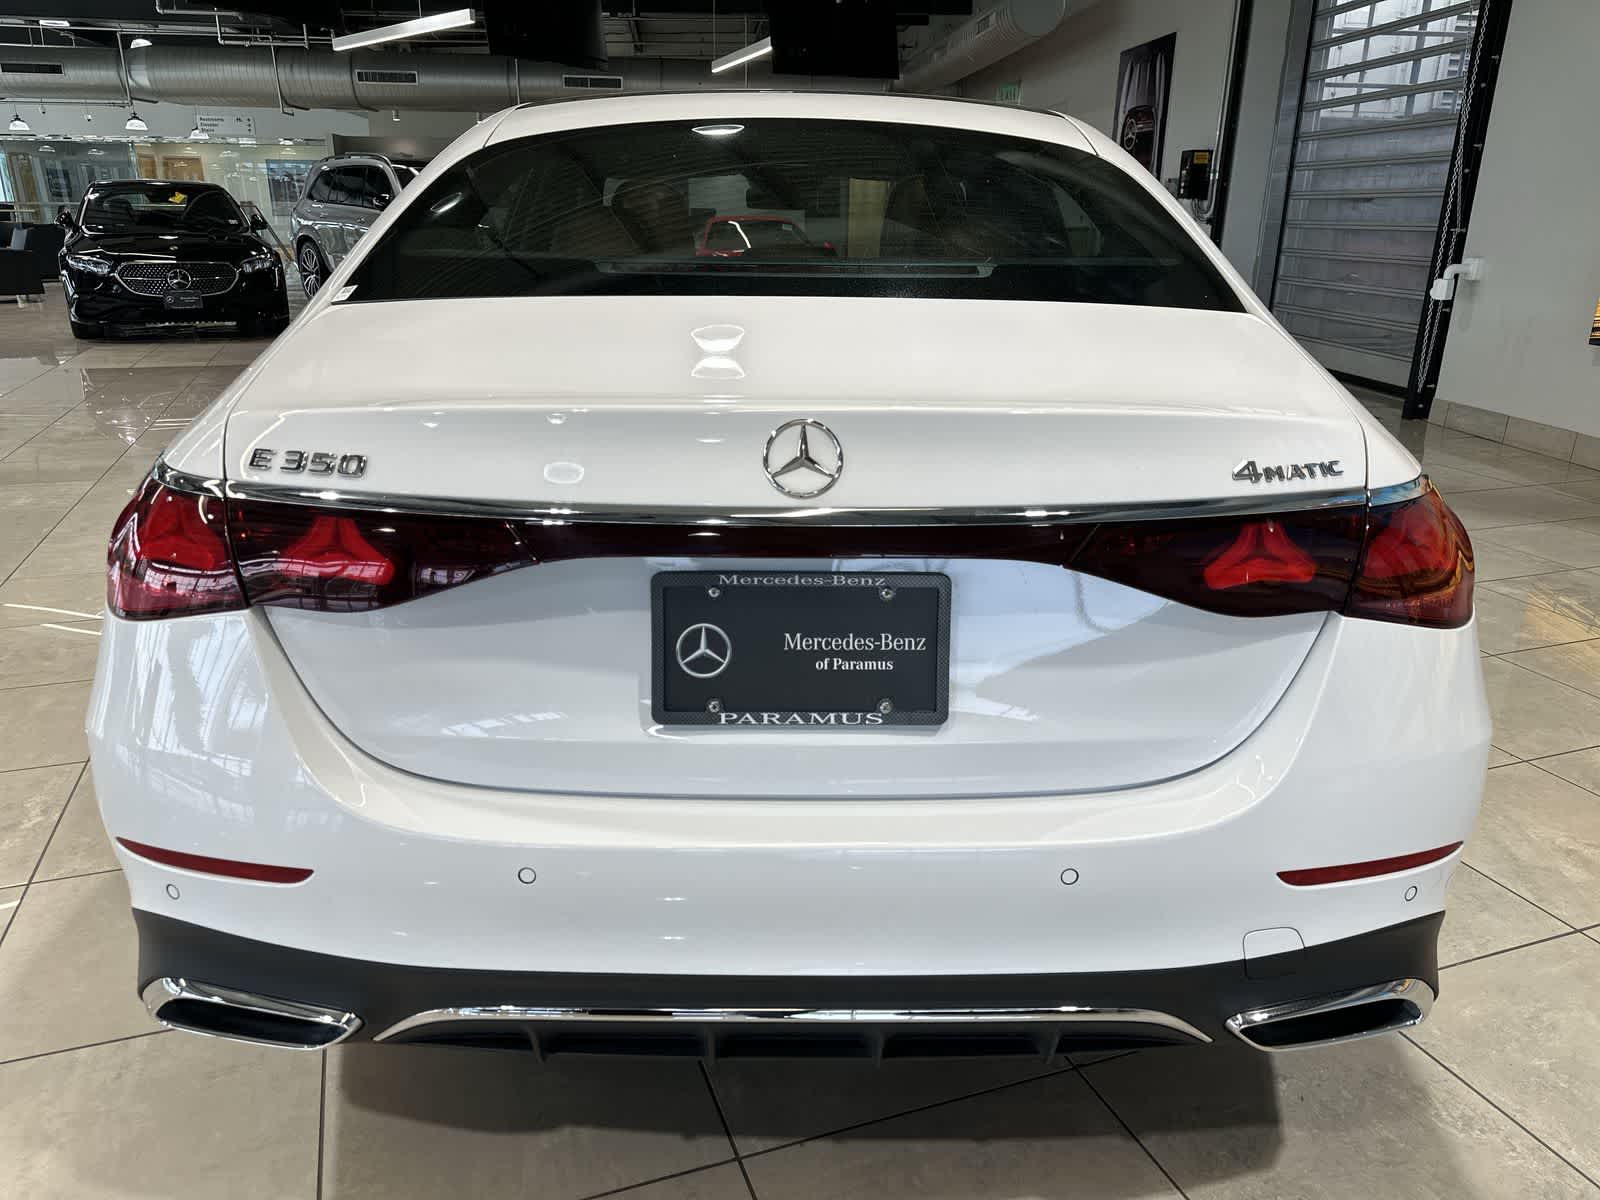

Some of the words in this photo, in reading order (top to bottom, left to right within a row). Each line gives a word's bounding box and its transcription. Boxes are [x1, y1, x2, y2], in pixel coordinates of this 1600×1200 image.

[249, 448, 276, 471] E
[280, 450, 367, 478] 350
[1231, 460, 1344, 484] 4MATIC
[718, 574, 886, 587] Mercedes-Benz
[783, 632, 926, 651] Mercedes-Benz
[815, 658, 831, 671] of
[832, 658, 894, 671] Paramus
[719, 712, 883, 725] PARAMUS
